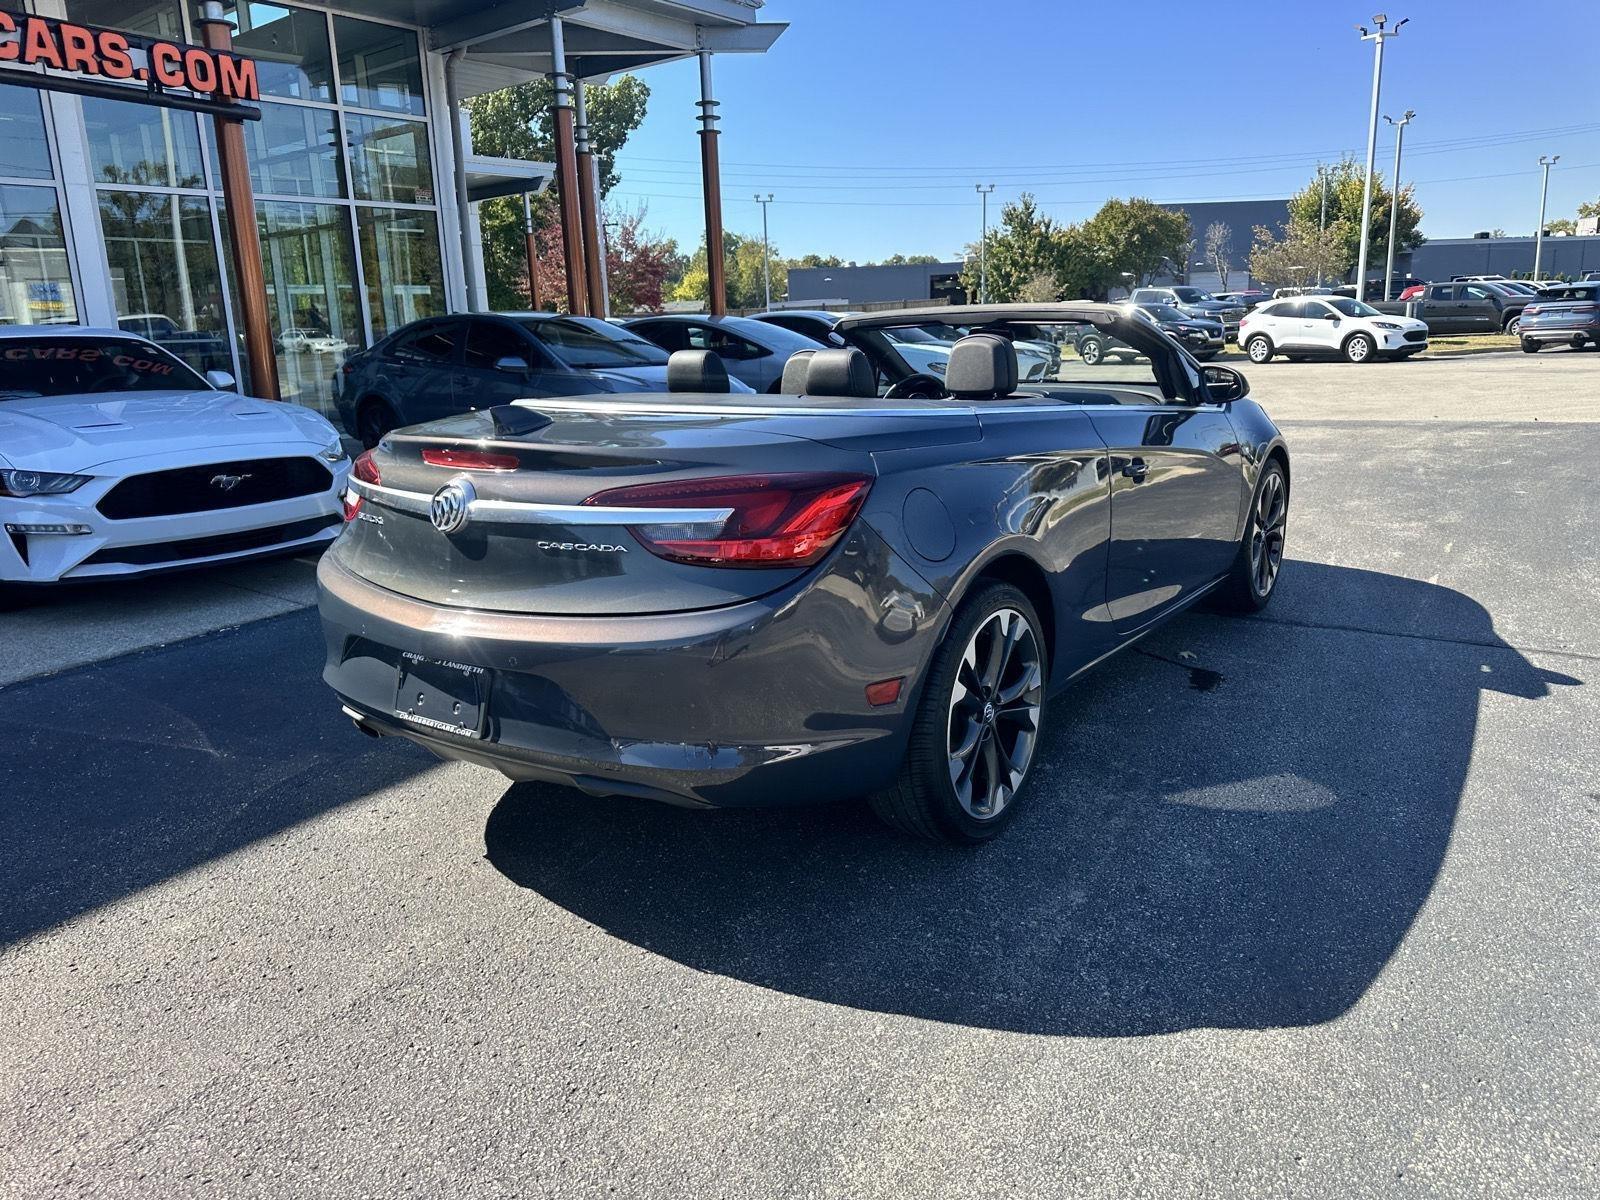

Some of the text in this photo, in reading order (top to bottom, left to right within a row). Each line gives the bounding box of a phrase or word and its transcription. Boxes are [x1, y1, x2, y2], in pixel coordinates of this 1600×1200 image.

[0, 11, 260, 100] CARS.COM
[537, 540, 629, 553] CASCADA
[402, 651, 425, 662] CRAIG
[442, 660, 484, 675] LANDRETH
